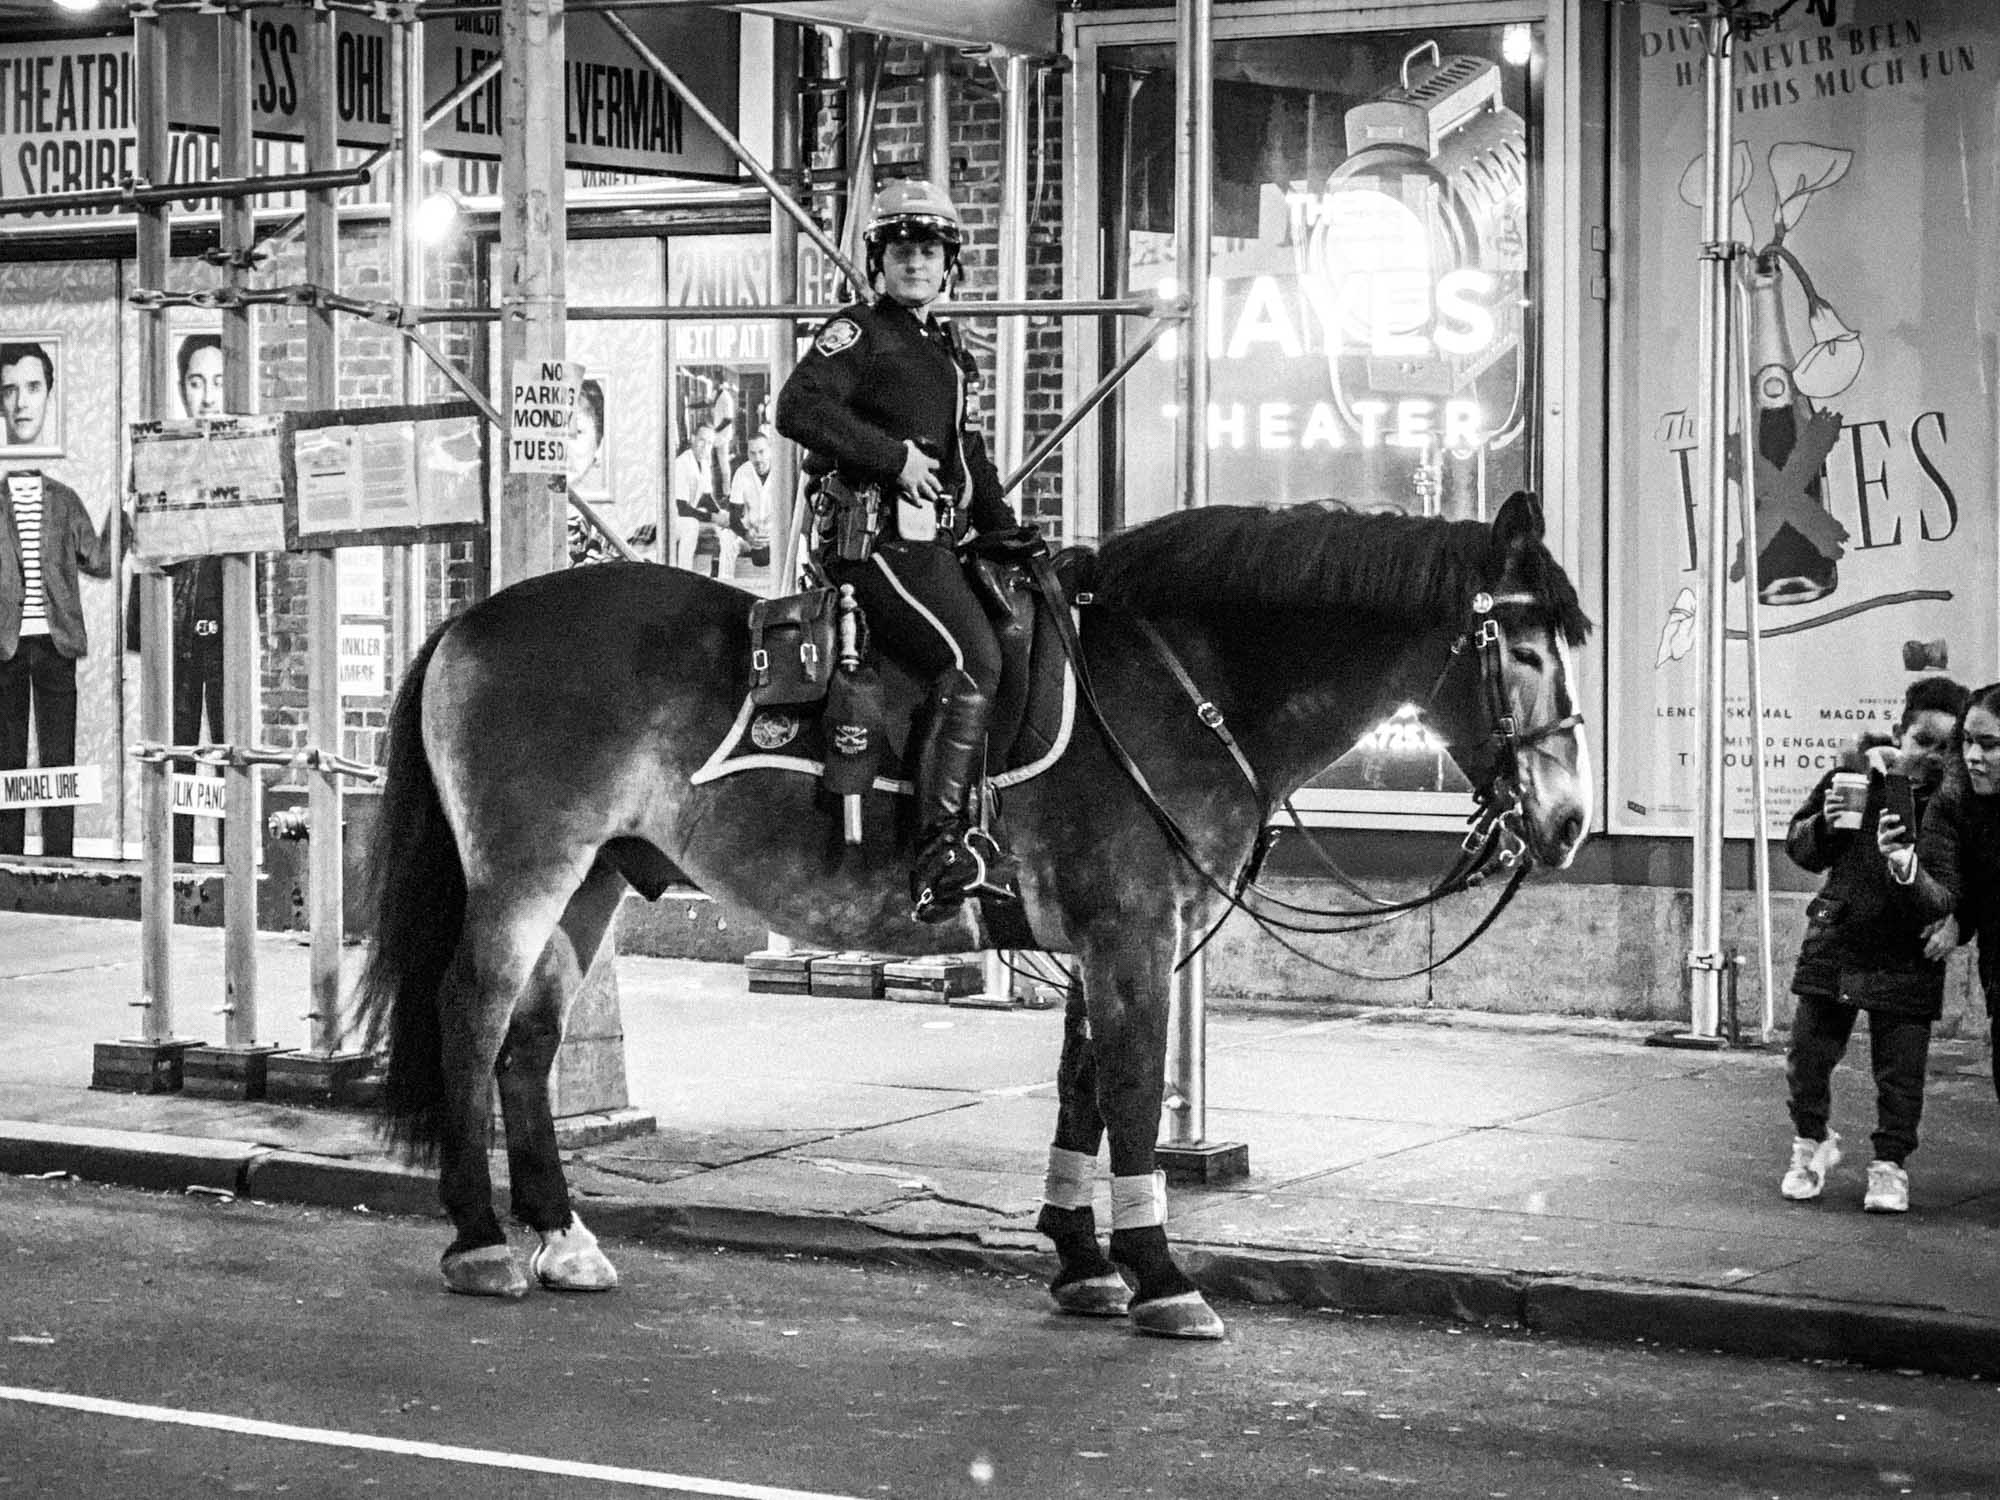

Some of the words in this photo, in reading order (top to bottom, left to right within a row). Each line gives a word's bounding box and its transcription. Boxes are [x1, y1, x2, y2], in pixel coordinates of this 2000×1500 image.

[1743, 36, 1834, 74] NEVER
[1848, 17, 1922, 55] BEEN
[337, 32, 391, 124] OHL
[1736, 78, 1800, 112] THIS
[1815, 58, 1904, 98] MUCH
[1920, 45, 1975, 80] FUN
[0, 51, 136, 134] THEATRI
[455, 46, 502, 136] LEI
[564, 59, 683, 154] LVERMAN
[542, 363, 563, 381] NO
[514, 386, 575, 406] PARKG
[514, 408, 575, 428] MONDY
[1160, 398, 1481, 449] HEATER
[514, 440, 568, 460] TUESD
[342, 637, 380, 656] INKLER
[1656, 706, 1696, 718] LENO
[1726, 708, 1793, 720] SKMAL
[1820, 709, 1876, 720] MAGDA
[1724, 737, 1775, 748] MITD
[1783, 737, 1843, 748] ENGAG
[1678, 753, 1785, 768] TOUH
[4, 774, 53, 802] MICHAEL
[56, 772, 80, 799] URIE
[173, 781, 193, 808] LIK
[197, 783, 226, 810] PANC
